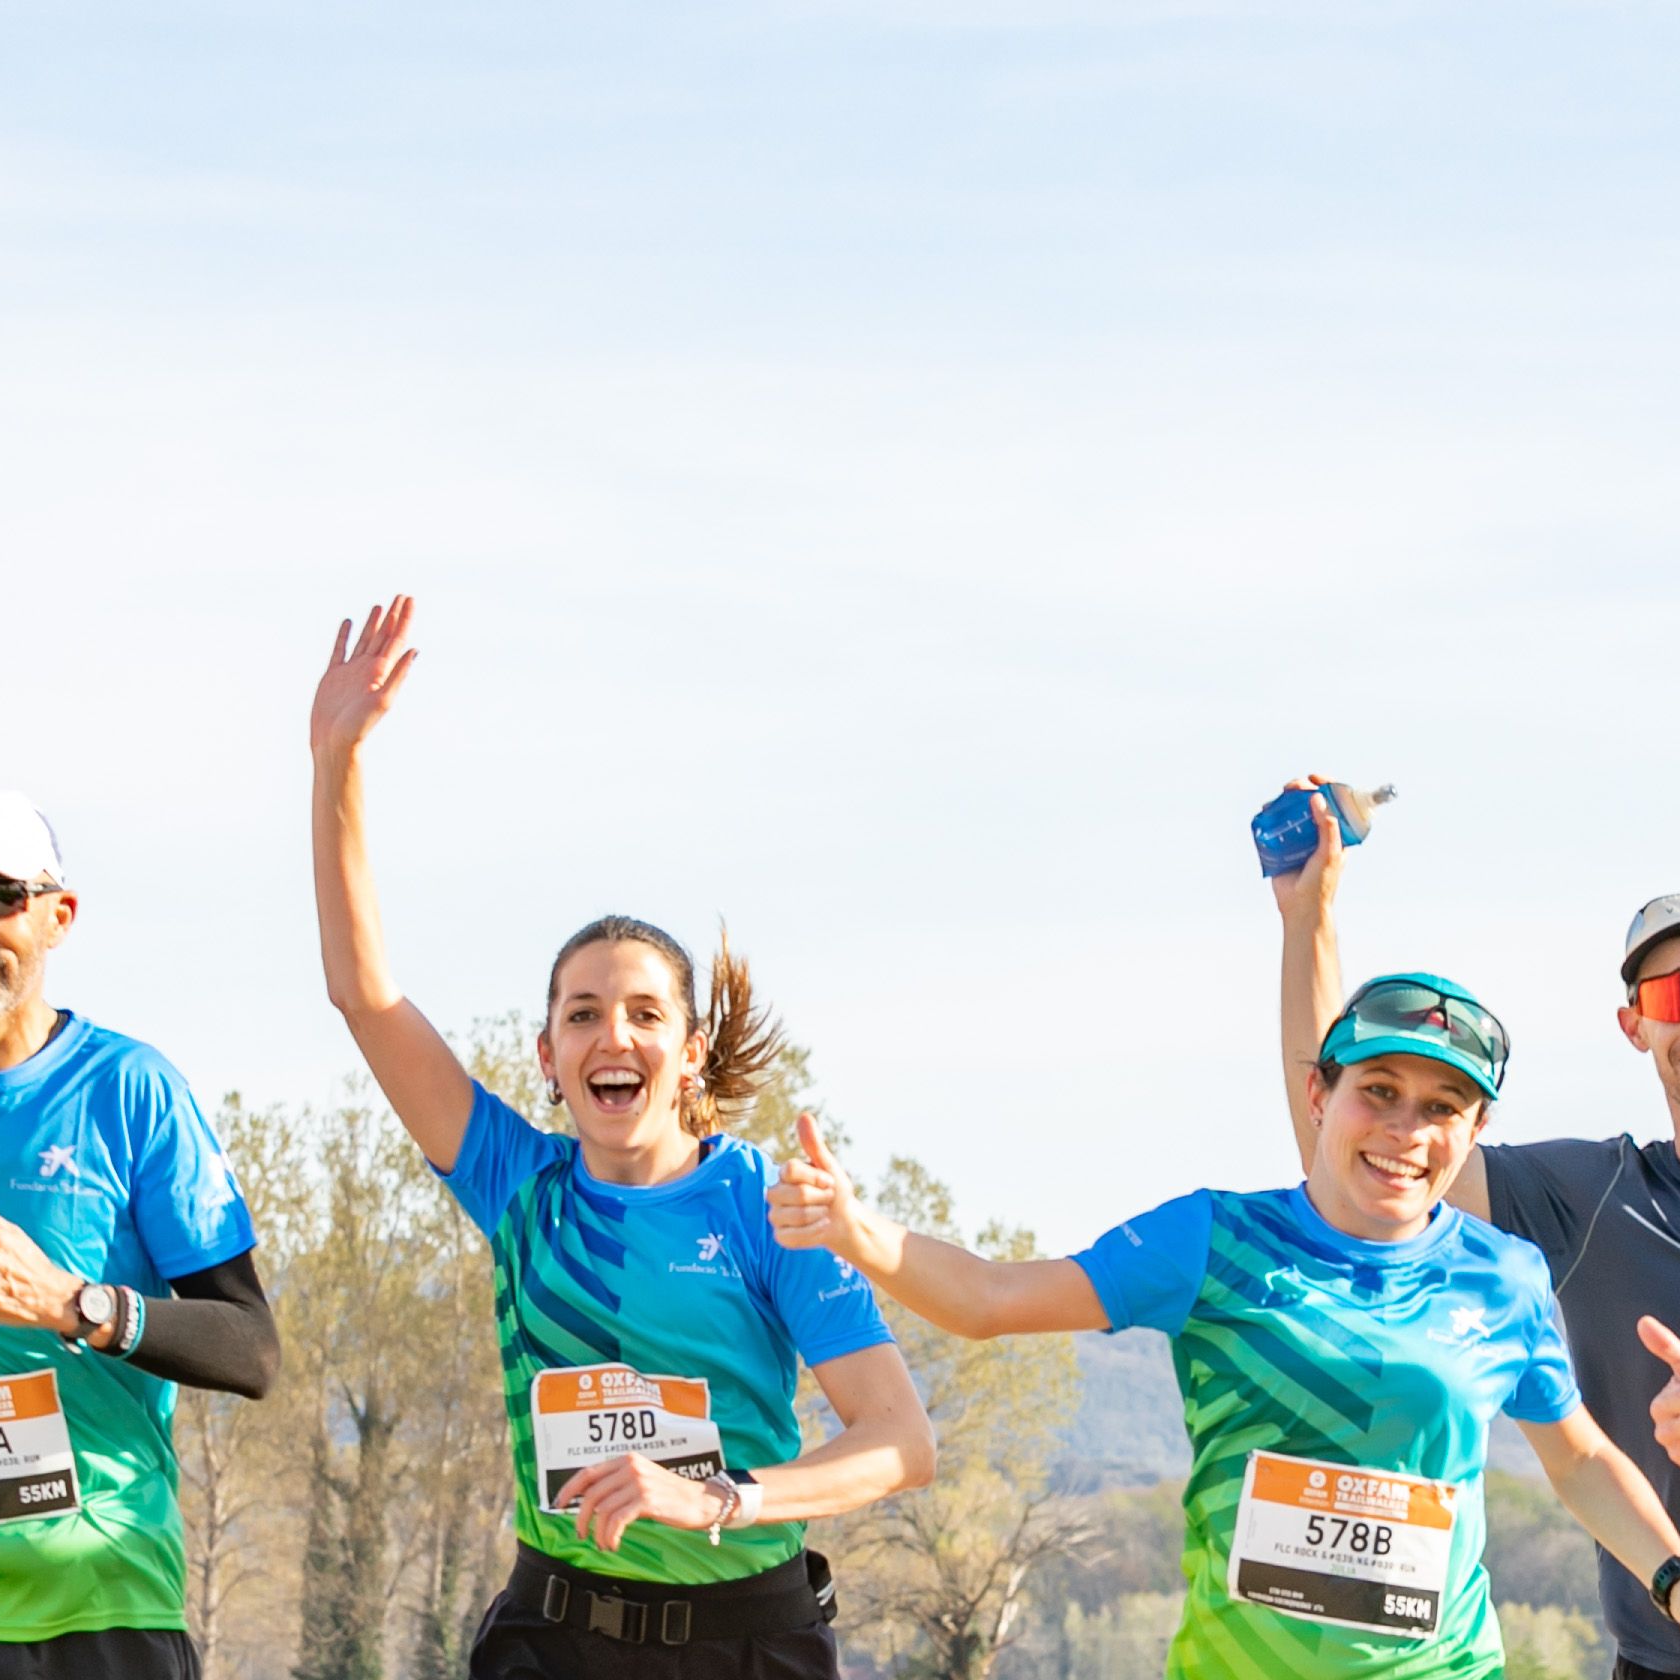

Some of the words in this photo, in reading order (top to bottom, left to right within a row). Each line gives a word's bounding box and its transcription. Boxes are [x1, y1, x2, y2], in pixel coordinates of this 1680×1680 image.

[600, 1371, 661, 1393] OXFAM
[588, 1410, 656, 1442] 578D
[583, 1445, 601, 1455] ROCK
[670, 1437, 688, 1446] RUN
[19, 1478, 68, 1504] 55KM
[1337, 1475, 1411, 1500] OXFAM
[1305, 1514, 1393, 1556] 578B
[1274, 1543, 1291, 1554] FLC
[1293, 1546, 1318, 1558] ROCK
[1383, 1593, 1432, 1620] 55KM
